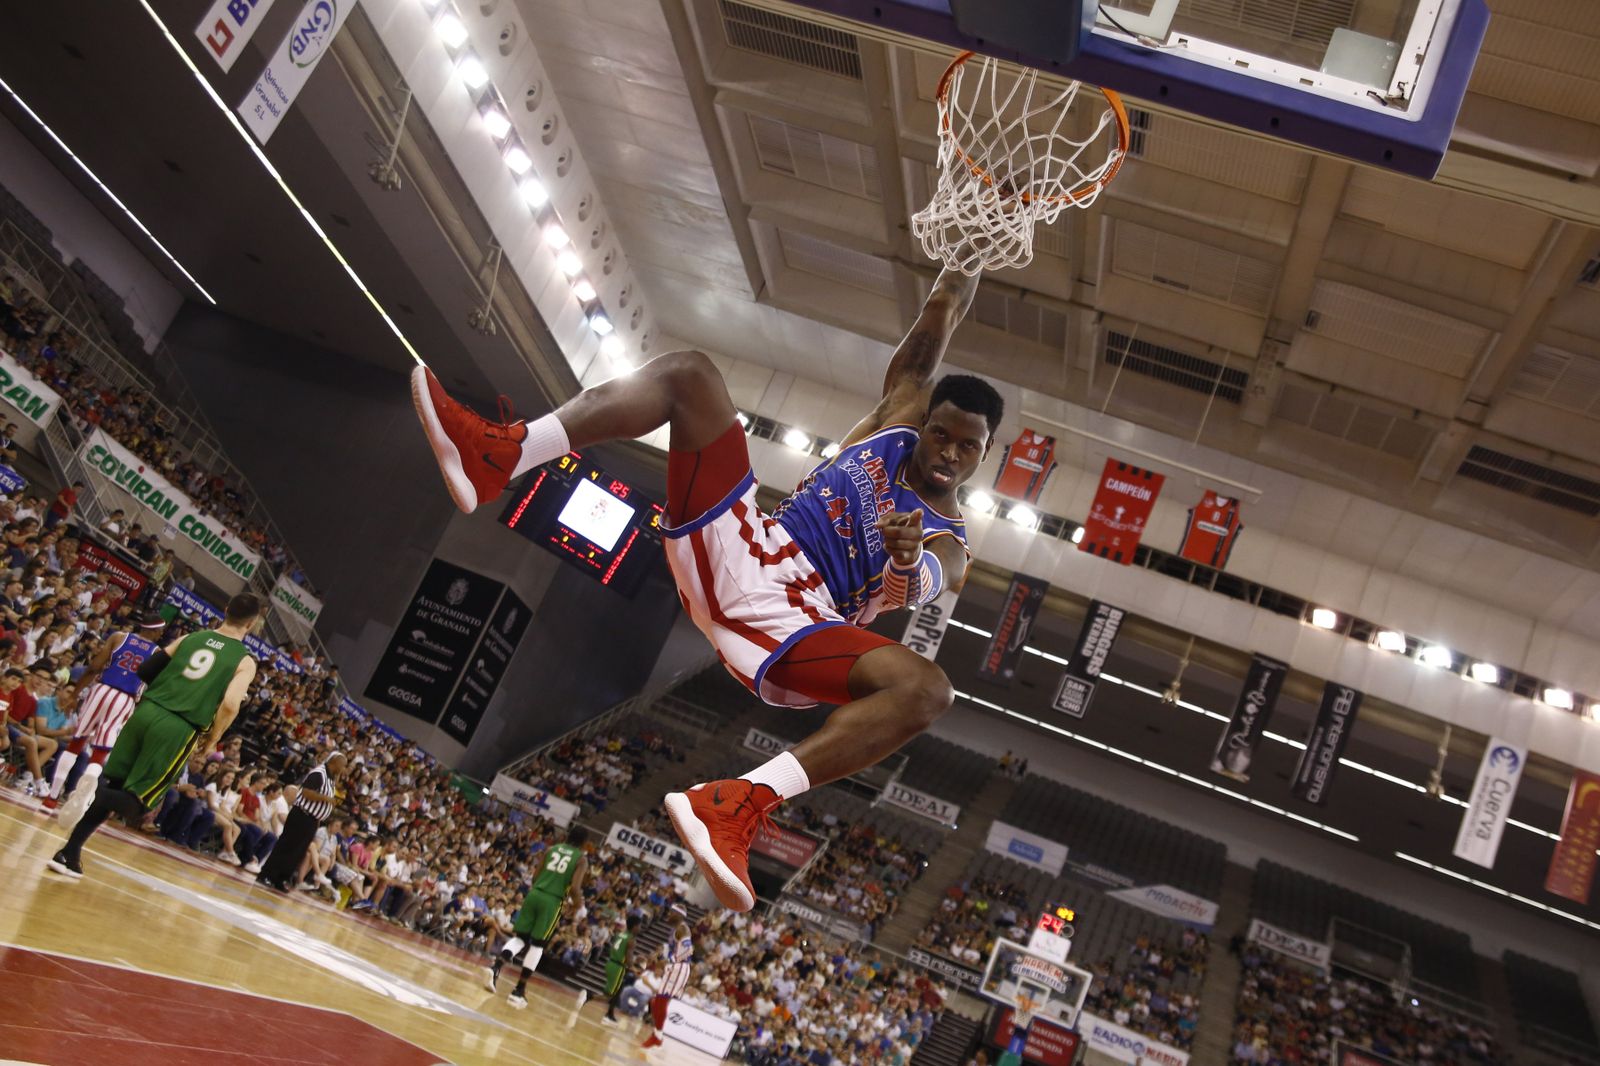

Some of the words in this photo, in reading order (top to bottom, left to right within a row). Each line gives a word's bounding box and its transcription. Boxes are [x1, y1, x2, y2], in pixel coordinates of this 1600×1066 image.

[227, 0, 259, 27] B
[293, 1, 332, 55] GNB
[559, 456, 577, 474] 91
[609, 480, 630, 499] 125
[862, 457, 896, 521] HARLE
[1106, 477, 1152, 502] CAMPEÓN
[86, 445, 180, 521] COVIRAN
[178, 514, 255, 580] COVIRAN
[272, 586, 318, 623] COVIRAN
[416, 595, 482, 627] AYUNTAMIENTO
[416, 609, 429, 620] DE
[430, 611, 470, 636] GRANADA
[1081, 615, 1105, 657] VERDAD
[205, 638, 225, 651] CARR
[1087, 608, 1124, 677] BURGERS
[118, 650, 145, 673] 26
[182, 649, 216, 680] 9
[388, 686, 421, 707] GOGSA
[751, 732, 786, 755] IDE
[889, 785, 952, 819] IDEAL
[1476, 778, 1511, 841] Cuerva
[617, 828, 667, 858] asisa
[546, 852, 572, 874] 26
[1038, 912, 1065, 936] 24
[1255, 924, 1323, 960] IDEAL
[1093, 1025, 1132, 1050] RADIO
